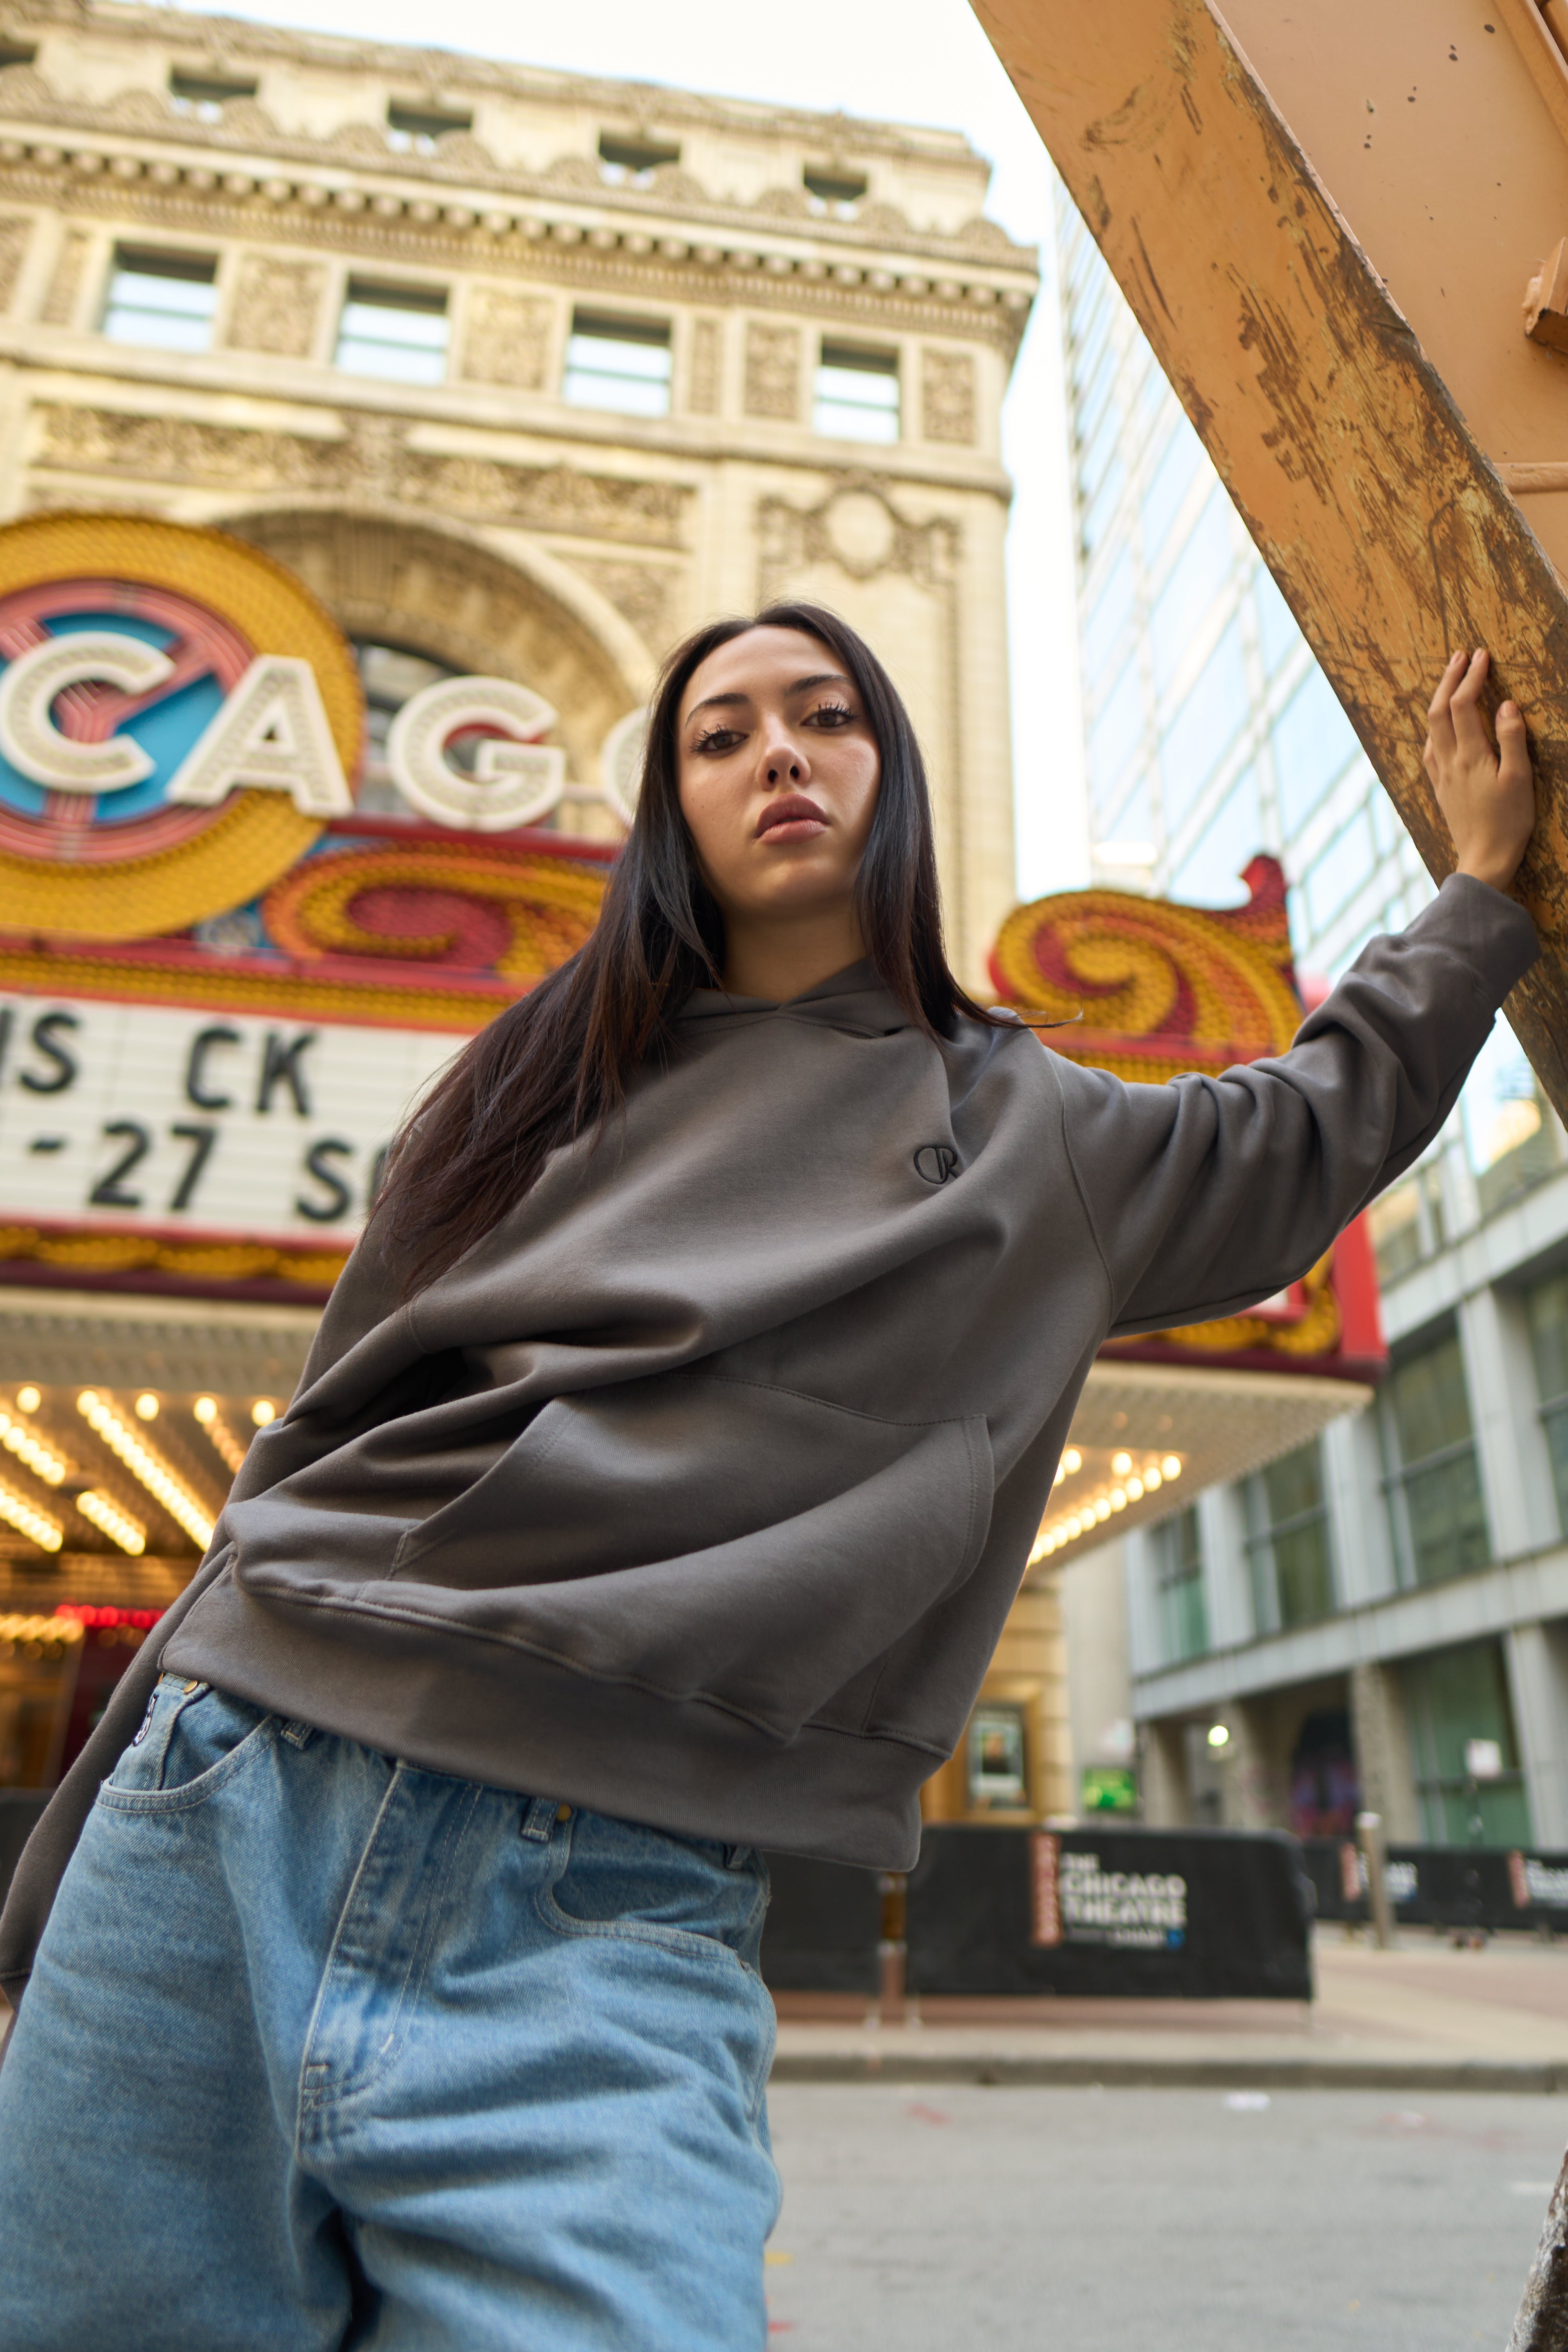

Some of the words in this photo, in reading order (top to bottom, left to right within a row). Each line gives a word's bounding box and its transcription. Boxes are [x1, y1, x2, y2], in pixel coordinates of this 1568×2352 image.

[185, 1025, 318, 1117] CK
[295, 1139, 392, 1222] S
[1060, 1852, 1100, 1871] THE
[1060, 1872, 1188, 1898] CHICAGO
[1063, 1896, 1188, 1928] THEATRE
